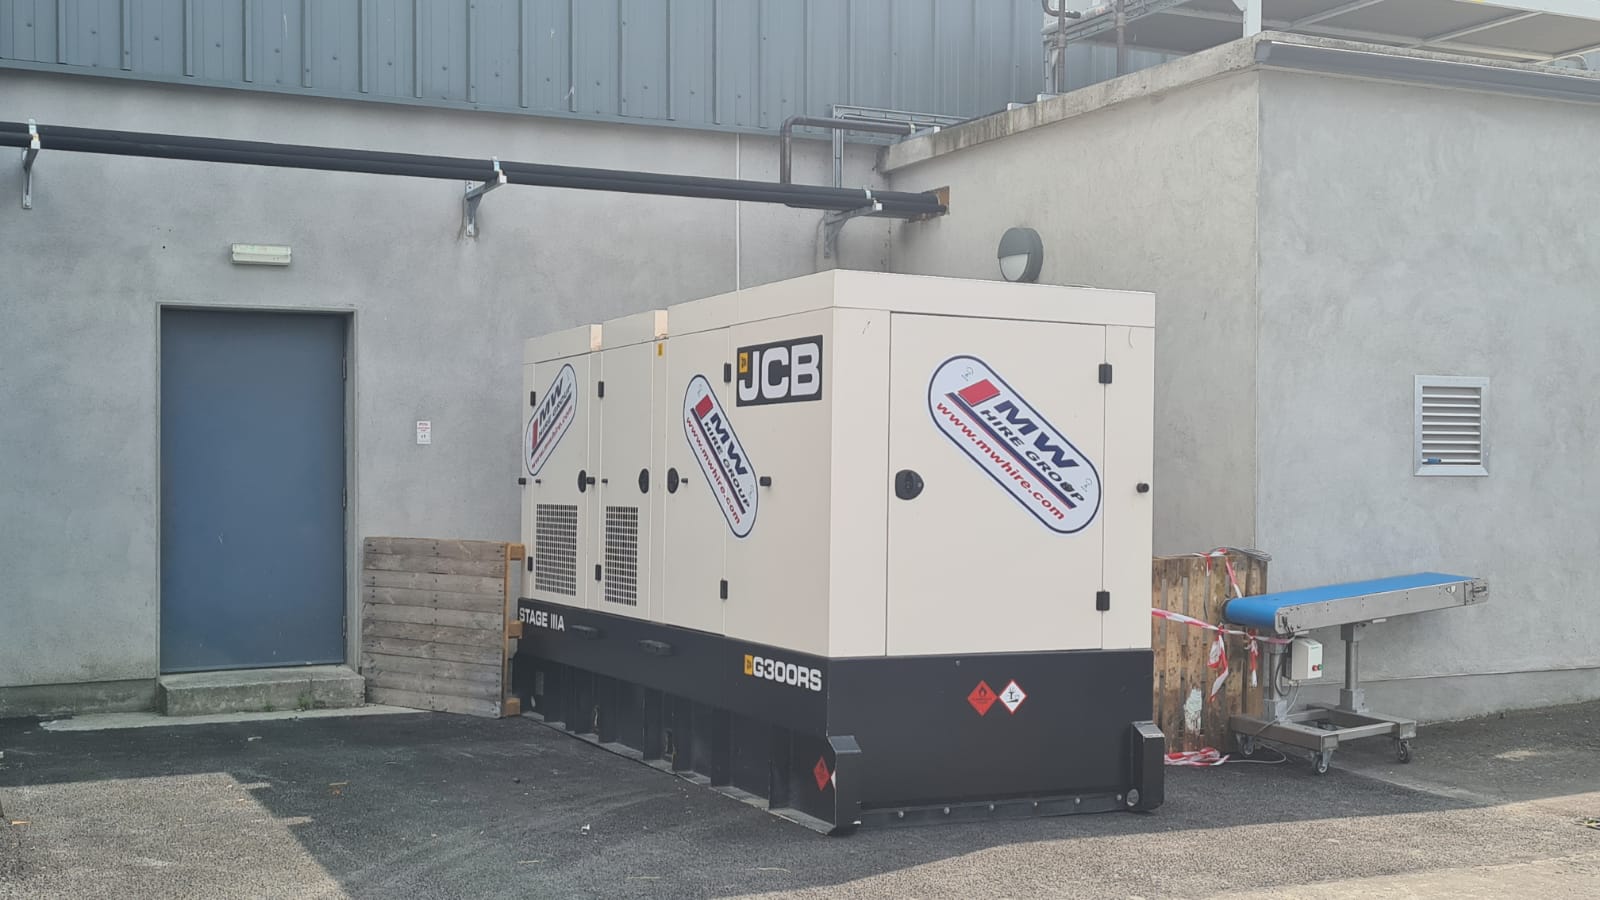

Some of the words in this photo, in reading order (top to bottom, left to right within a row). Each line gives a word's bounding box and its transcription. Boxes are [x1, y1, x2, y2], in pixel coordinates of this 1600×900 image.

[539, 376, 563, 427] MW
[739, 342, 820, 401] JCB
[710, 412, 748, 475] MW
[980, 409, 1025, 447] HIRE
[993, 400, 1080, 468] MW
[687, 417, 740, 524] www.mwhire.com
[704, 421, 723, 454] HIRE
[723, 458, 750, 508] GROUP
[936, 402, 1065, 520] www.mwhire.com
[519, 607, 548, 628] STAGE
[550, 612, 565, 632] IIIA
[753, 656, 822, 692] G300RS
